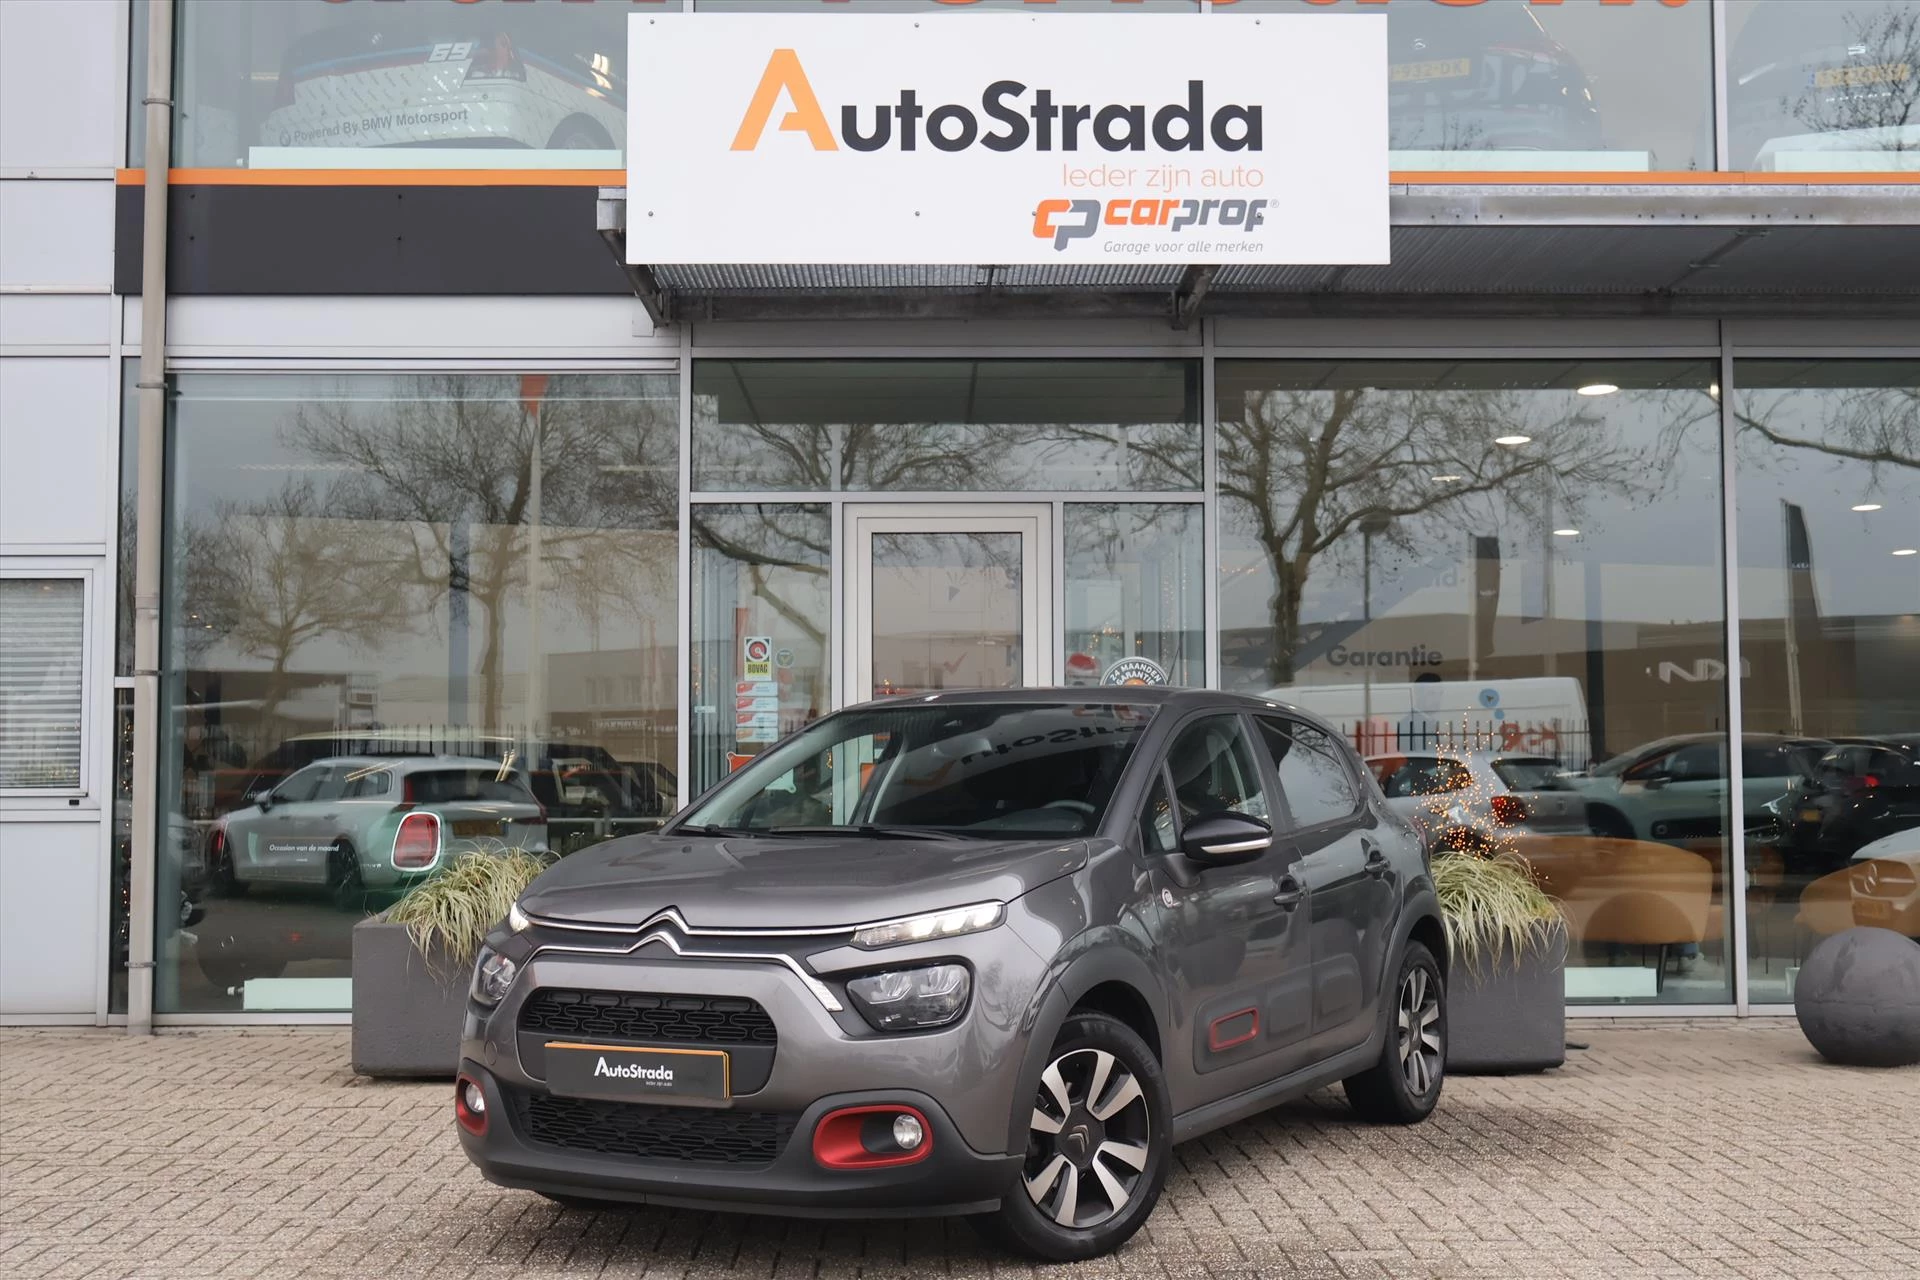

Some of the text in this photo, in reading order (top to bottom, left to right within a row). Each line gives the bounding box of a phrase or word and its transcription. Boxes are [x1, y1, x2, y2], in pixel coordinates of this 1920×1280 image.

[428, 42, 473, 62] 69
[729, 49, 1263, 152] AutoStrada
[293, 109, 468, 142] Powered By BMW Motorsport
[1063, 164, 1264, 193] Ieder zijn auto
[1104, 240, 1264, 256] Garage voor alle merken
[1326, 644, 1443, 667] Garantie
[747, 663, 768, 674] BOVAG
[1116, 670, 1155, 686] GARANTIE
[1121, 662, 1162, 683] MAANDEN
[308, 843, 317, 852] de
[317, 843, 340, 852] maand
[594, 1056, 673, 1080] AutoStrada
